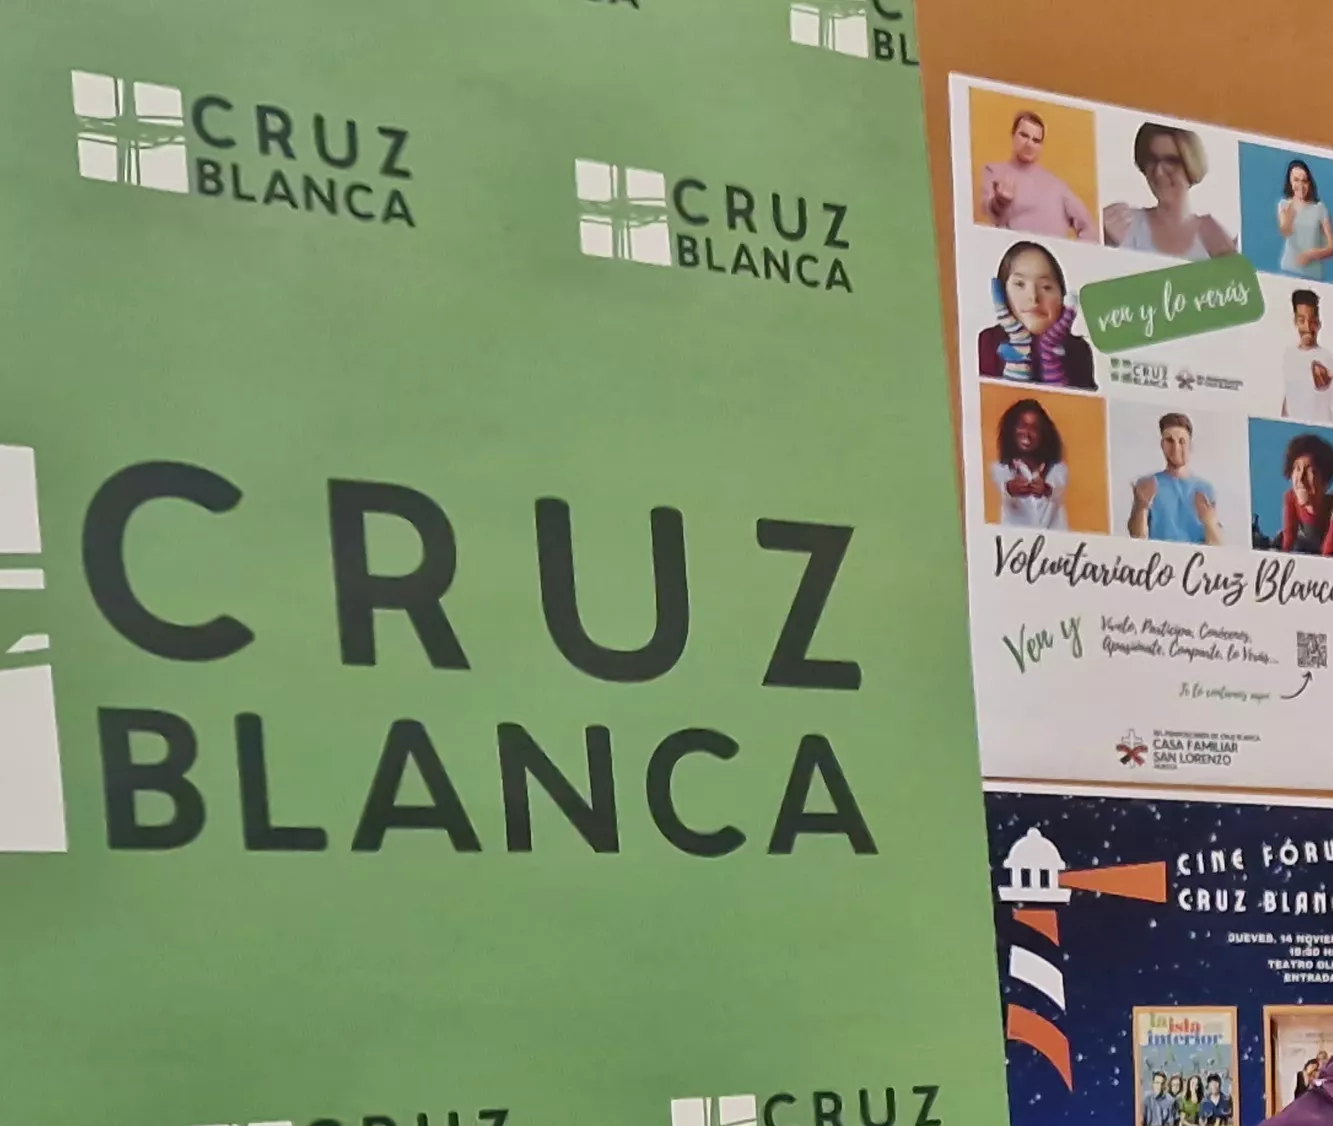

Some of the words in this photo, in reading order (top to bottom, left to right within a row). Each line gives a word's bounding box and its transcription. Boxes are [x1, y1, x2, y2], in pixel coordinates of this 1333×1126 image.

[191, 95, 412, 180] CRUZ
[195, 157, 418, 229] BLANCA
[672, 178, 852, 250] CRUZ
[676, 233, 855, 295] BLANCA
[1140, 304, 1157, 338] y
[1164, 279, 1187, 322] lo
[81, 460, 863, 691] CRUZ
[995, 534, 1175, 592] Voluntariado
[1182, 552, 1248, 607] Cruz
[1003, 624, 1054, 674] Ven
[1060, 616, 1084, 659] y
[1153, 739, 1184, 751] CASA
[1187, 740, 1239, 754] FAMILIAR
[1153, 751, 1177, 763] SAN
[1180, 753, 1232, 766] LORENZO
[97, 706, 879, 856] BLANCA
[1176, 847, 1244, 876] CINE
[1177, 887, 1247, 913] CRUZ
[1268, 959, 1313, 970] TEATRO
[1147, 1030, 1224, 1046] interior
